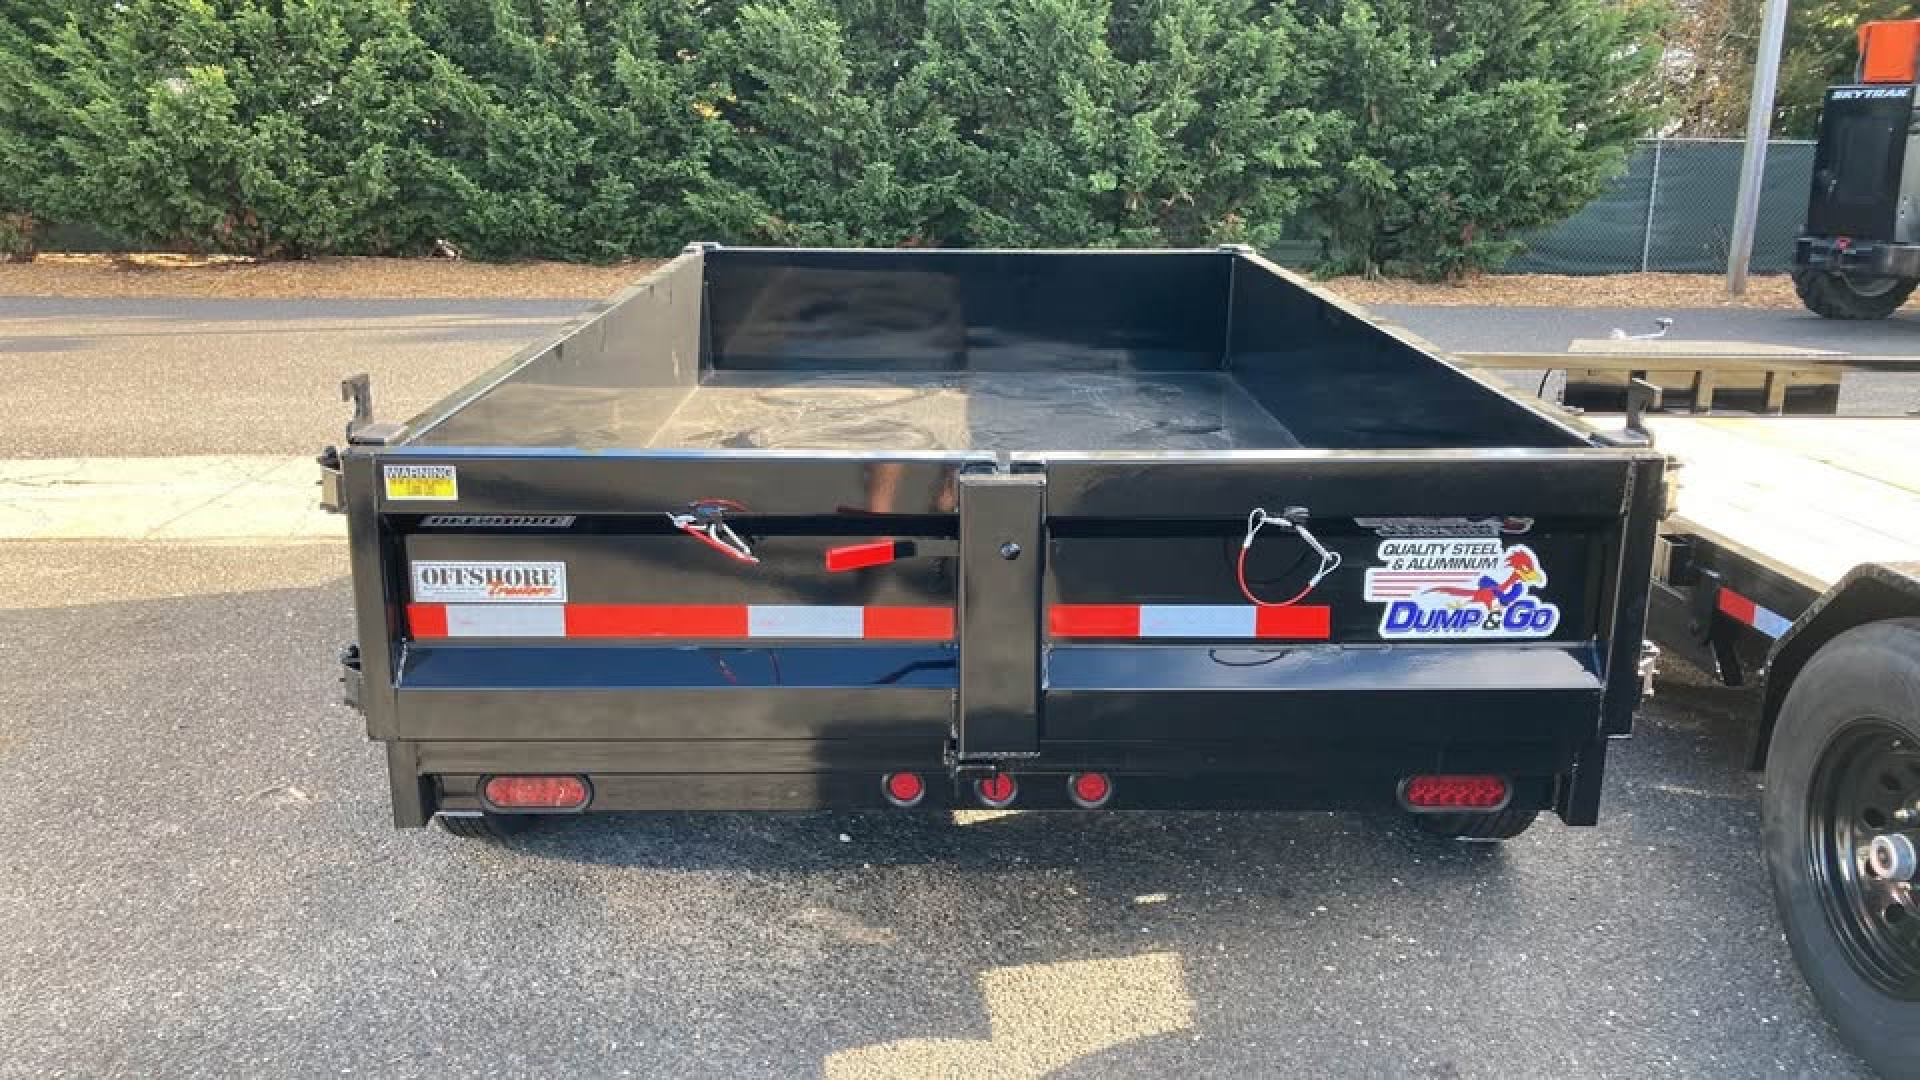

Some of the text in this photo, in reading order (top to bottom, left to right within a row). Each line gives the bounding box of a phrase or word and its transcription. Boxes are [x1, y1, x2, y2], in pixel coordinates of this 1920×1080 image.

[1832, 88, 1910, 100] SKYTRAK
[386, 466, 451, 479] WARNING
[1382, 543, 1499, 556] QUALITY STEEL
[1392, 557, 1499, 570] & ALUMINUM
[421, 567, 557, 586] OFFSHORE
